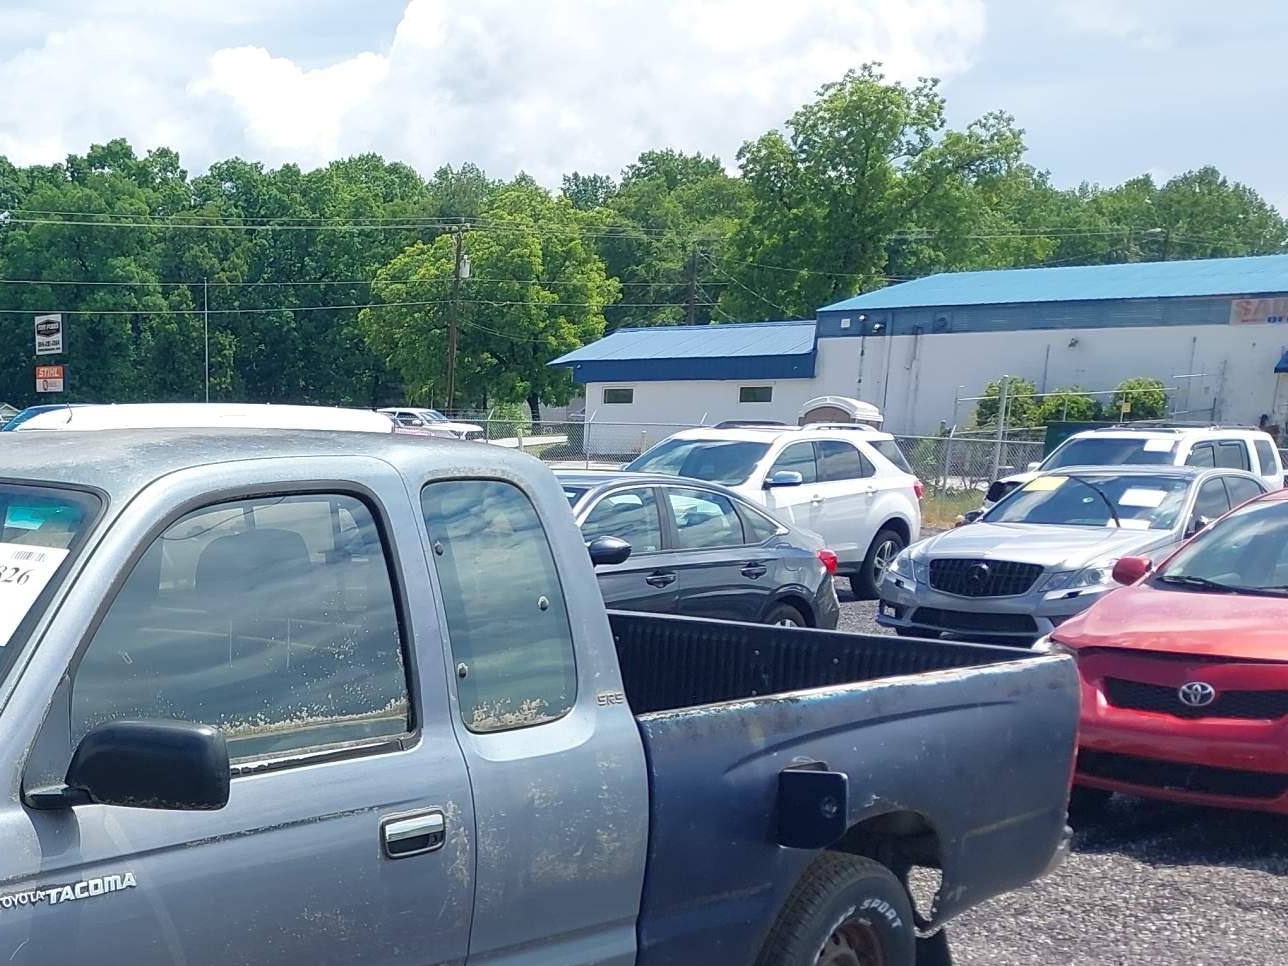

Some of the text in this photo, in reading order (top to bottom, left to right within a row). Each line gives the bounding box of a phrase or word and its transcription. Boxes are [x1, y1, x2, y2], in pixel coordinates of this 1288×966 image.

[38, 367, 60, 378] STIHL
[44, 872, 136, 905] TACOMA
[860, 898, 903, 929] SPORT
